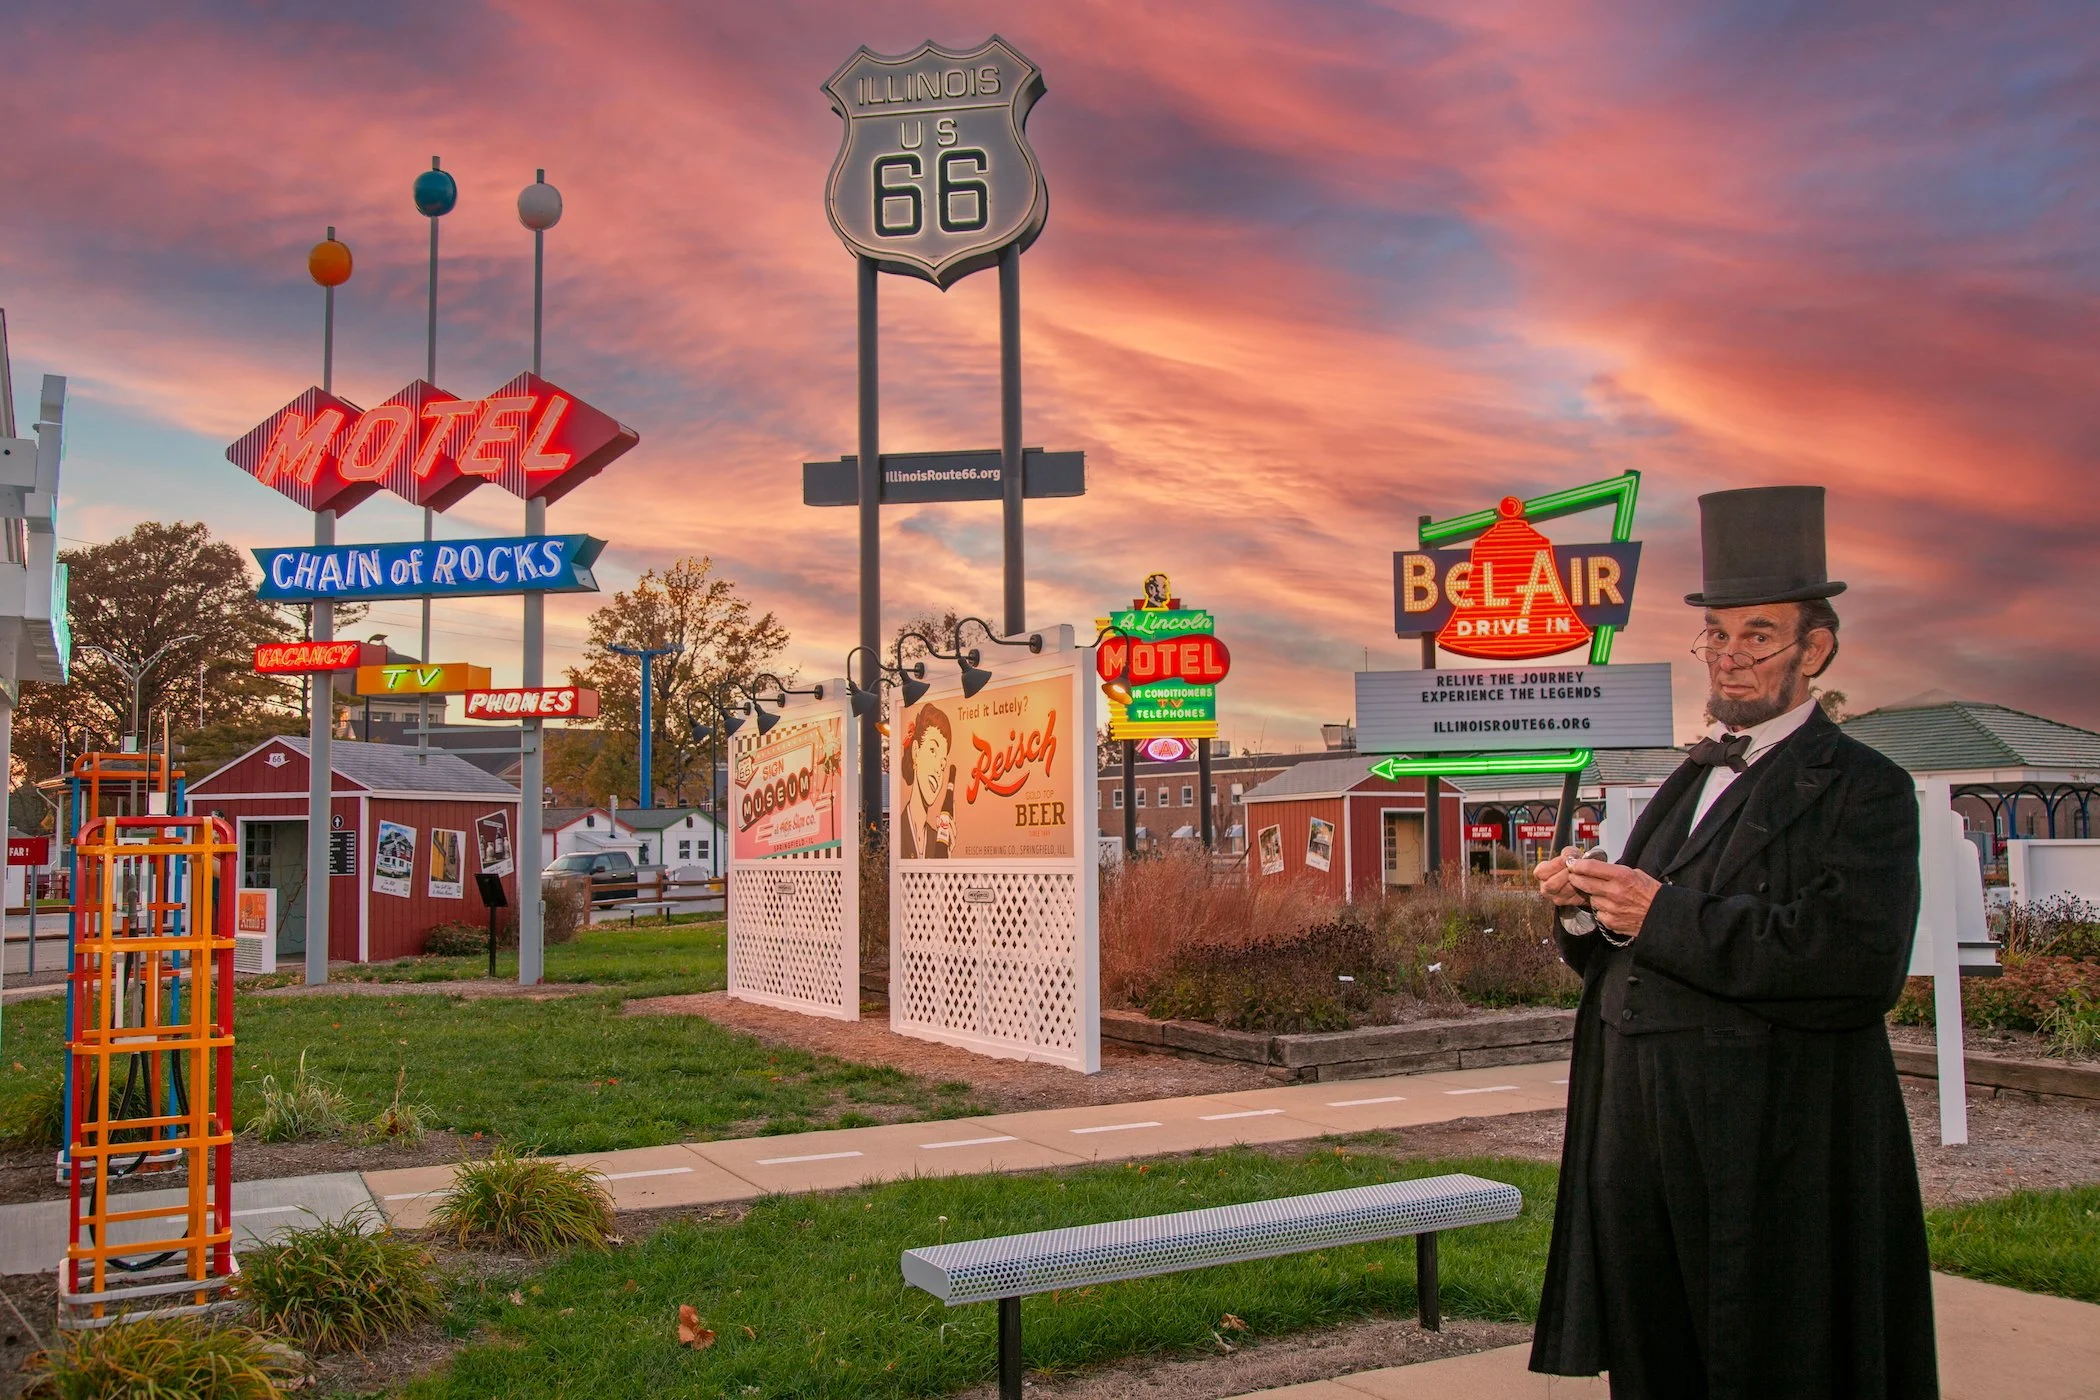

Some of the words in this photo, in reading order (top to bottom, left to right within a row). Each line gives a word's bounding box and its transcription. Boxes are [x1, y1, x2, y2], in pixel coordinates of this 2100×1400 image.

[858, 64, 1001, 106] ILLINOIS
[871, 146, 991, 238] 66
[257, 394, 571, 487] MOTEL
[885, 468, 1001, 484] IllinoisRoute66.org
[271, 548, 382, 591] CHAIN
[390, 546, 423, 586] of
[432, 540, 565, 584] ROCKS
[1515, 549, 1625, 616] AIR
[1138, 611, 1212, 634] Lincoln
[1457, 618, 1529, 636] DRIVE
[1546, 617, 1571, 634] IN
[256, 643, 357, 669] VACANCY
[1103, 643, 1223, 677] MOTEL
[1436, 675, 1486, 687] RELIVE
[1491, 674, 1515, 685] THE
[1520, 671, 1584, 684] JOURNEY
[468, 690, 573, 714] PHONES
[1144, 687, 1213, 699] CONDITIONERS
[1421, 689, 1504, 703] EXPERIENCE
[1511, 688, 1534, 700] THE
[1540, 686, 1601, 699] LEGENDS
[957, 706, 980, 721] Tried
[982, 703, 990, 717] it
[993, 696, 1029, 717] Lately?
[1136, 708, 1206, 719] TELEPHONES
[1433, 718, 1590, 733] ILLINOISROUTE66.ORG
[272, 755, 282, 763] 66
[966, 708, 1057, 805] Reisch
[1151, 740, 1181, 757] AAA
[762, 758, 785, 781] SIGN
[743, 775, 809, 818] MUSEUM
[1025, 791, 1041, 800] GOLD
[1043, 789, 1055, 799] TOP
[1015, 801, 1066, 827] BEER
[773, 838, 805, 853] SPRINGFIELD
[965, 846, 983, 856] REISCH
[983, 845, 1007, 856] BREWING
